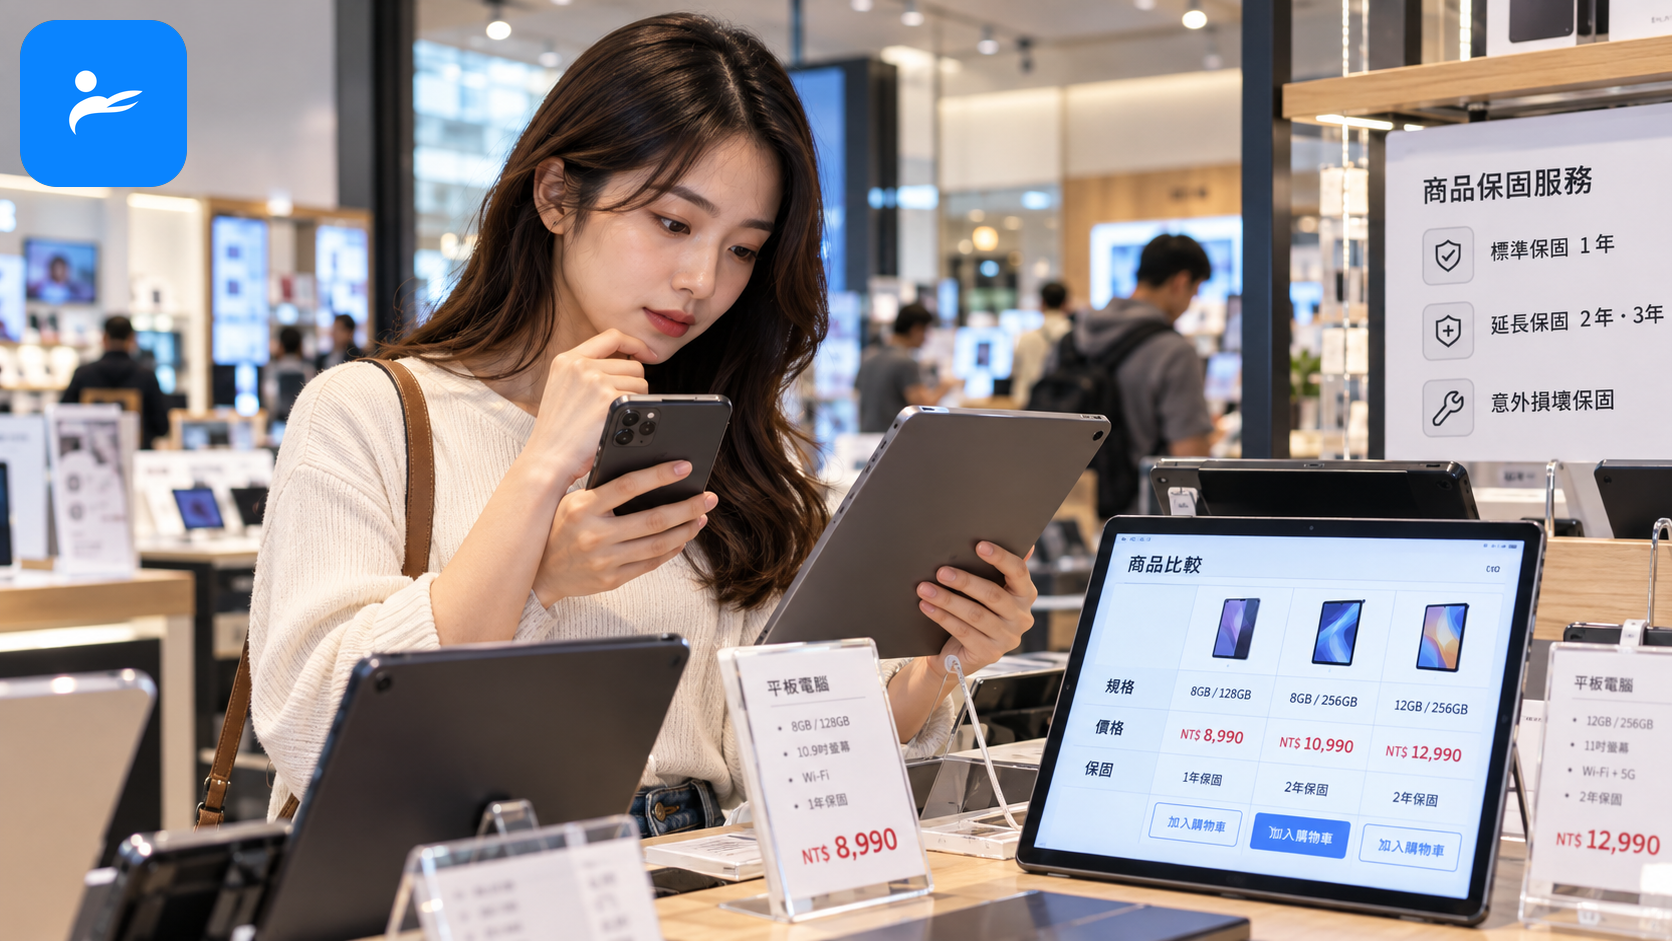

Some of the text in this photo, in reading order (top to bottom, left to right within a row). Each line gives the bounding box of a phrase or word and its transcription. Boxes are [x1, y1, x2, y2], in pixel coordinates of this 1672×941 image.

[1423, 165, 1592, 204] 商品保固服務
[1490, 238, 1569, 262] 標準保固
[1490, 311, 1569, 335] 延長保固
[1491, 389, 1615, 413] 意外損壞保固
[1127, 555, 1203, 574] 商品比較
[767, 675, 830, 697] 平板電腦
[1105, 678, 1135, 695] 規格
[1574, 675, 1634, 693] 平板電腦
[1190, 686, 1211, 698] 8GB
[1219, 688, 1252, 700] 128GB
[1289, 692, 1312, 705] 8GB
[1321, 694, 1358, 708] 256GB
[1394, 700, 1423, 713] 12GB
[1431, 702, 1469, 715] 256GB
[791, 720, 812, 732] 8GB
[819, 716, 850, 729] 128GB
[1095, 719, 1125, 736] 價格
[1586, 715, 1612, 727] 12GB
[1620, 718, 1654, 730] 256GB
[1180, 728, 1244, 744] NT$ 8,990
[1279, 736, 1354, 754] NT$ 10,990
[1385, 745, 1462, 763] NT$ 12,990
[802, 769, 830, 783] Wi-Fi
[1085, 760, 1114, 778] 保固
[1582, 765, 1609, 778] Wi-Fi
[1620, 768, 1636, 780] 5G
[1182, 771, 1223, 787] 1年保固
[1284, 781, 1329, 797] 2年保固
[808, 793, 848, 810] 1年保固
[1392, 791, 1439, 808] 2年保固
[1579, 791, 1623, 806] 2年保固
[1167, 815, 1226, 833] 加入購物車
[802, 827, 897, 865] NT$ 8,990
[1556, 829, 1661, 856] NT$ 12,990
